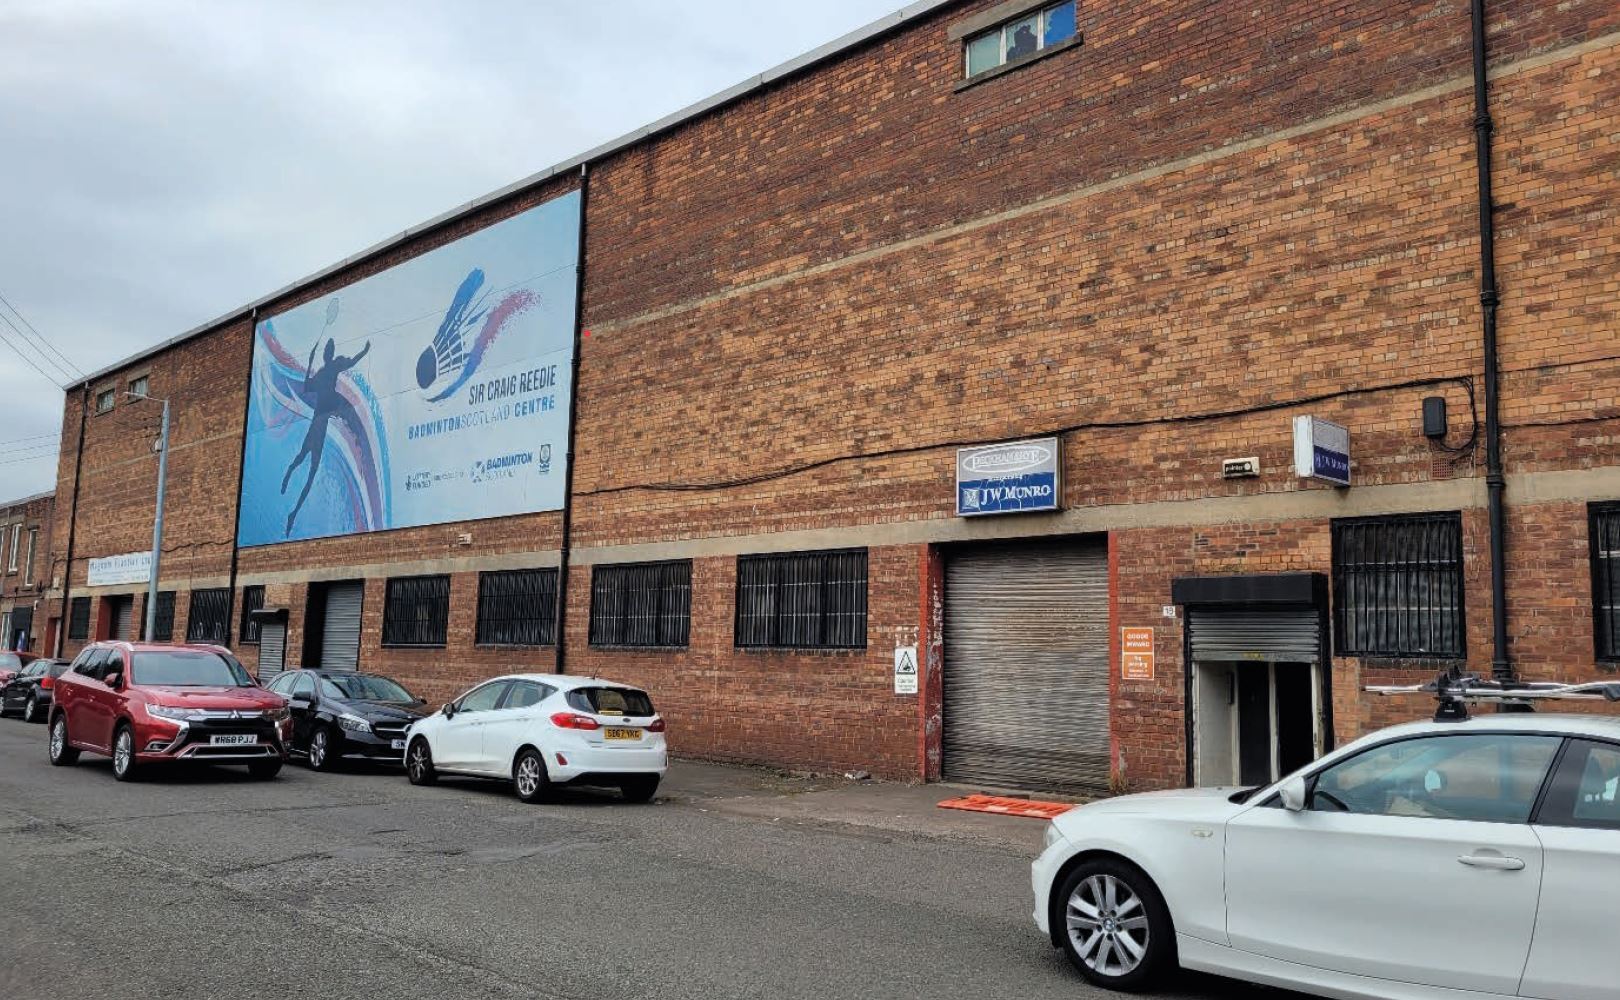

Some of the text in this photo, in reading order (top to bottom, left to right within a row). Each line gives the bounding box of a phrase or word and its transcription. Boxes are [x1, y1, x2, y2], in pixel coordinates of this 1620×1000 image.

[468, 364, 557, 406] SIR CRAIG REEDIE
[514, 394, 555, 417] CENTRE
[486, 451, 533, 471] BADMINTON
[1005, 485, 1052, 500] MUNRO
